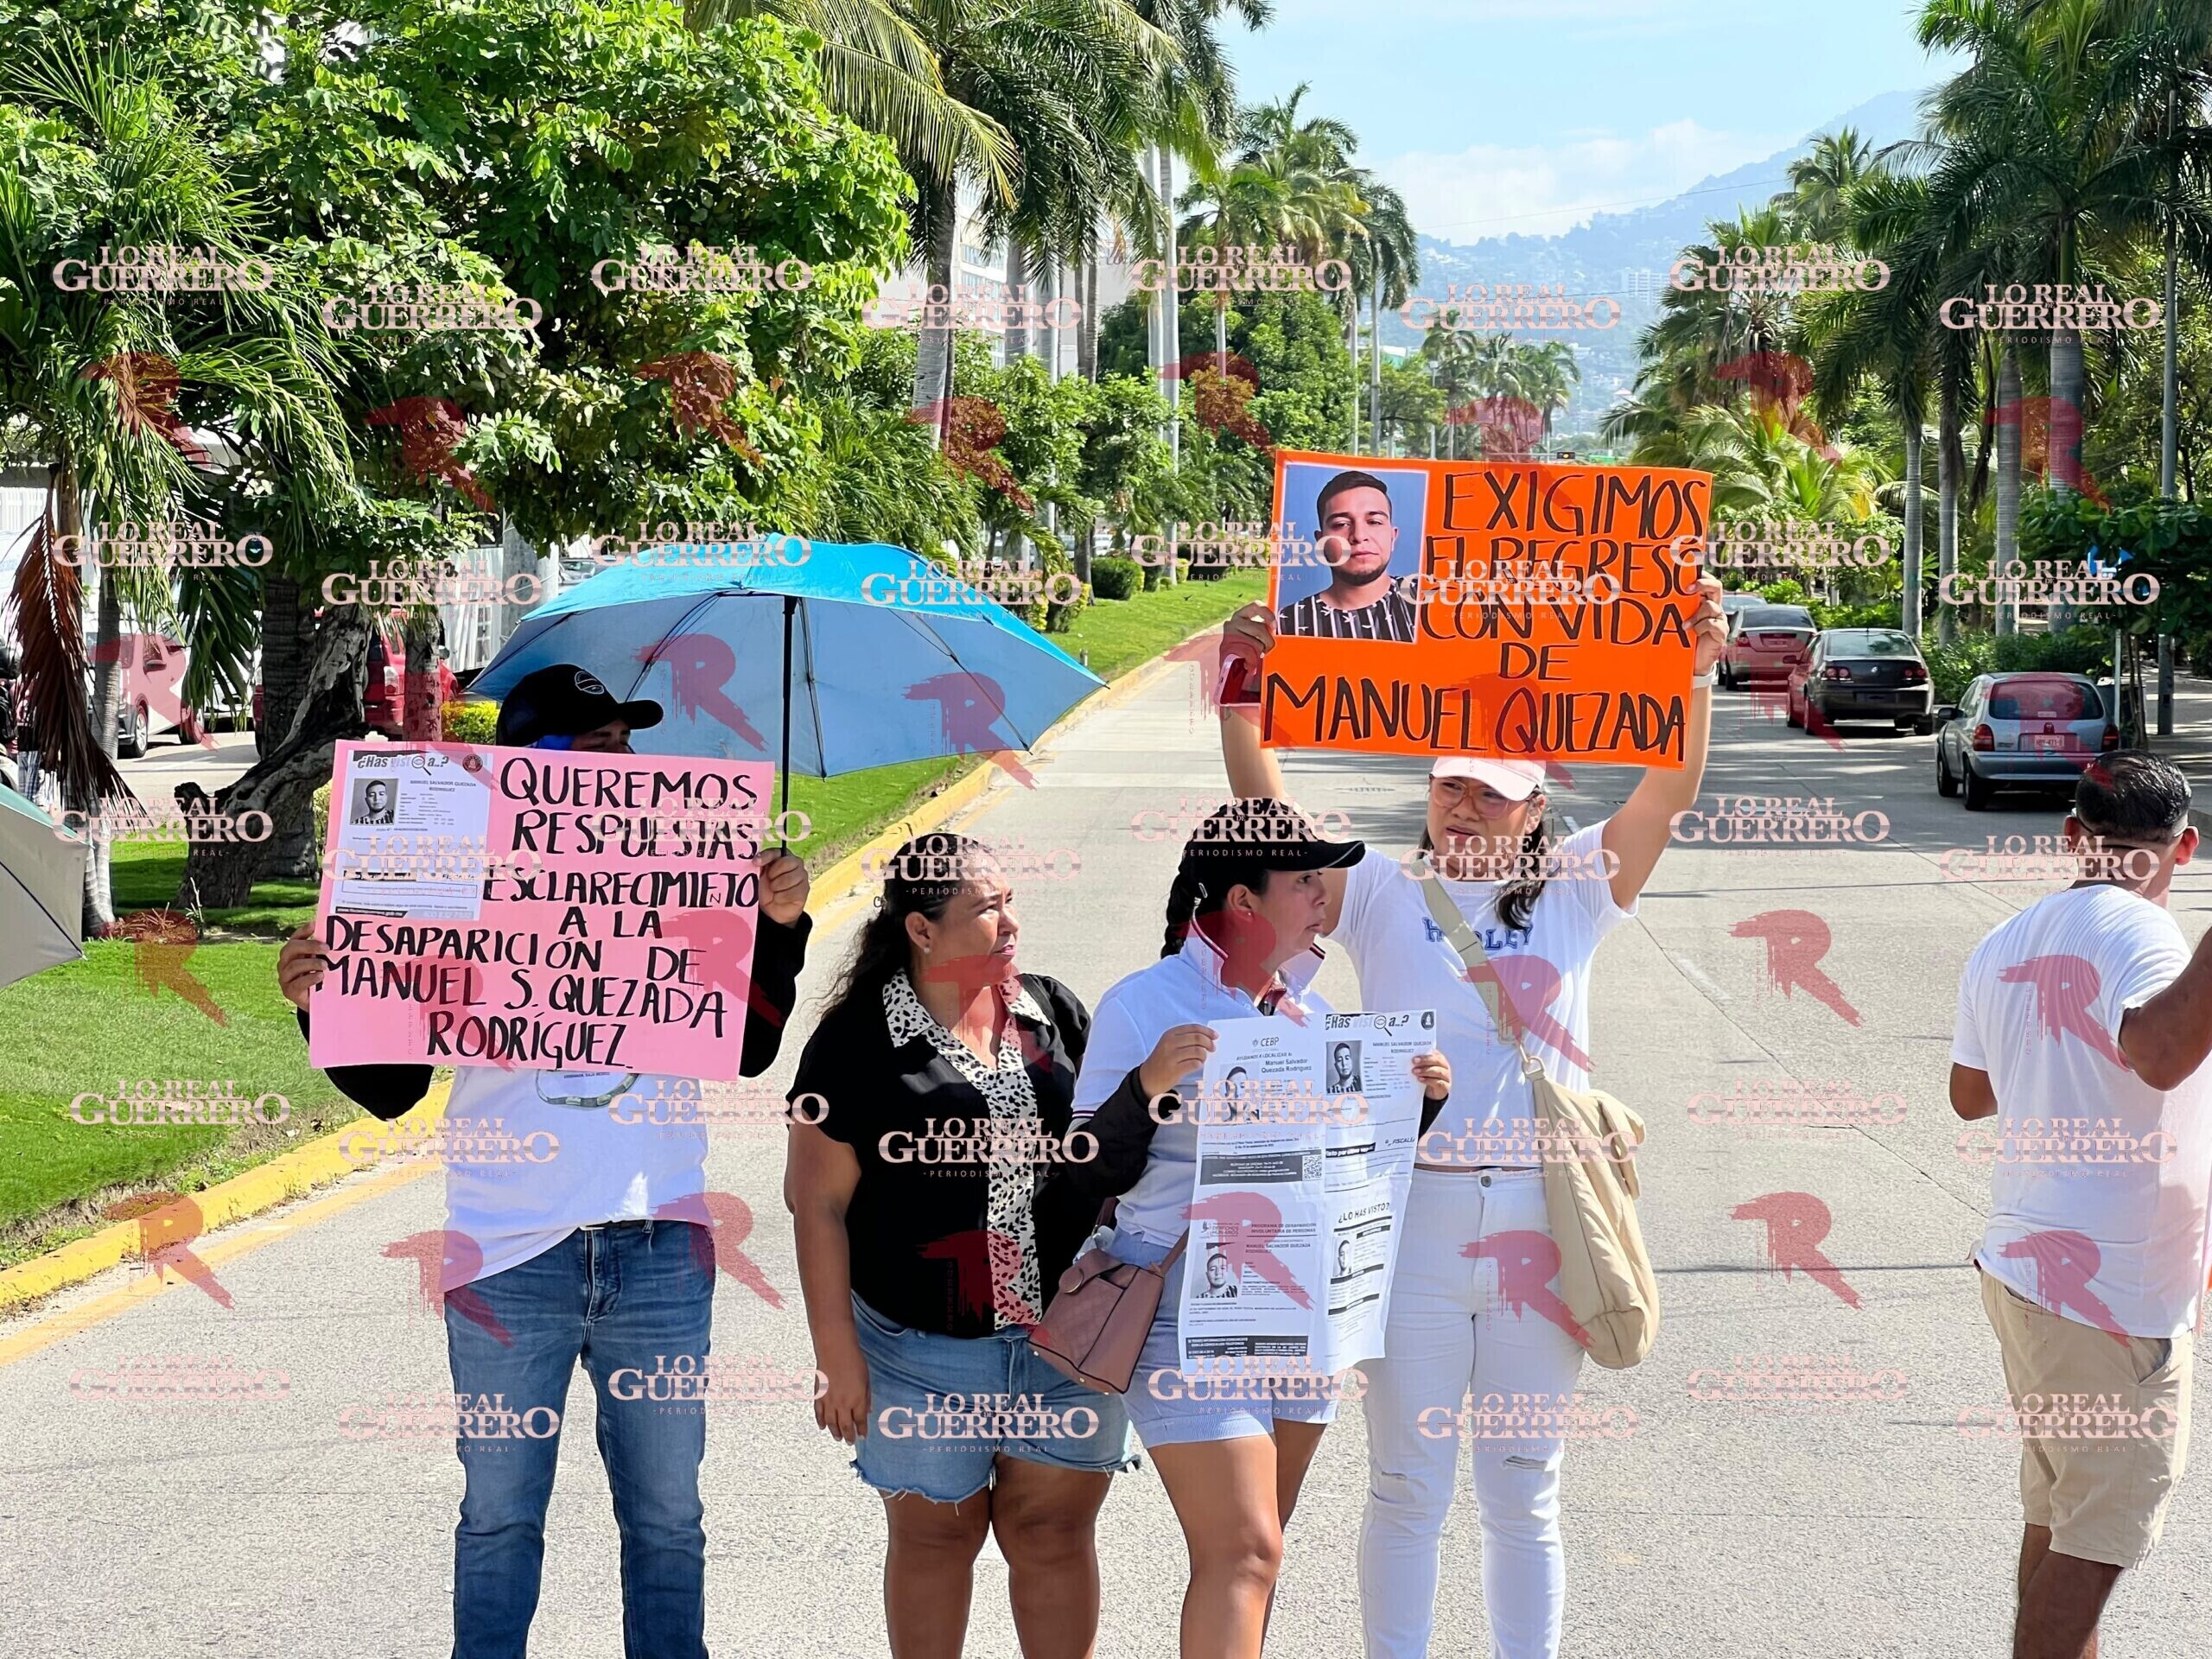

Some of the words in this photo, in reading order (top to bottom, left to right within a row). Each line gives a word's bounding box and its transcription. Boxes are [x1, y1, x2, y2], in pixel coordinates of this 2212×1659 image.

[1443, 469, 1707, 540] EXIGIMOS
[1427, 535, 1465, 590] EL
[1491, 536, 1705, 597] REGRESO
[1421, 596, 1533, 640] CON
[1547, 597, 1692, 648] VIDA
[1498, 642, 1580, 681] DE
[1262, 672, 1487, 752] MANUEL
[1495, 686, 1686, 761] QUEZADA
[500, 757, 758, 810] QUEREMOS
[512, 810, 758, 861] RESPUESTAS
[558, 906, 588, 938] A
[613, 910, 663, 938] LA
[326, 915, 602, 972] DESAPARICIÓN
[646, 946, 707, 986] DE
[315, 954, 486, 1006] MANUEL
[504, 969, 538, 1008] S.
[550, 973, 728, 1038] QUEZADA
[1368, 1202, 1390, 1215] VISTO?
